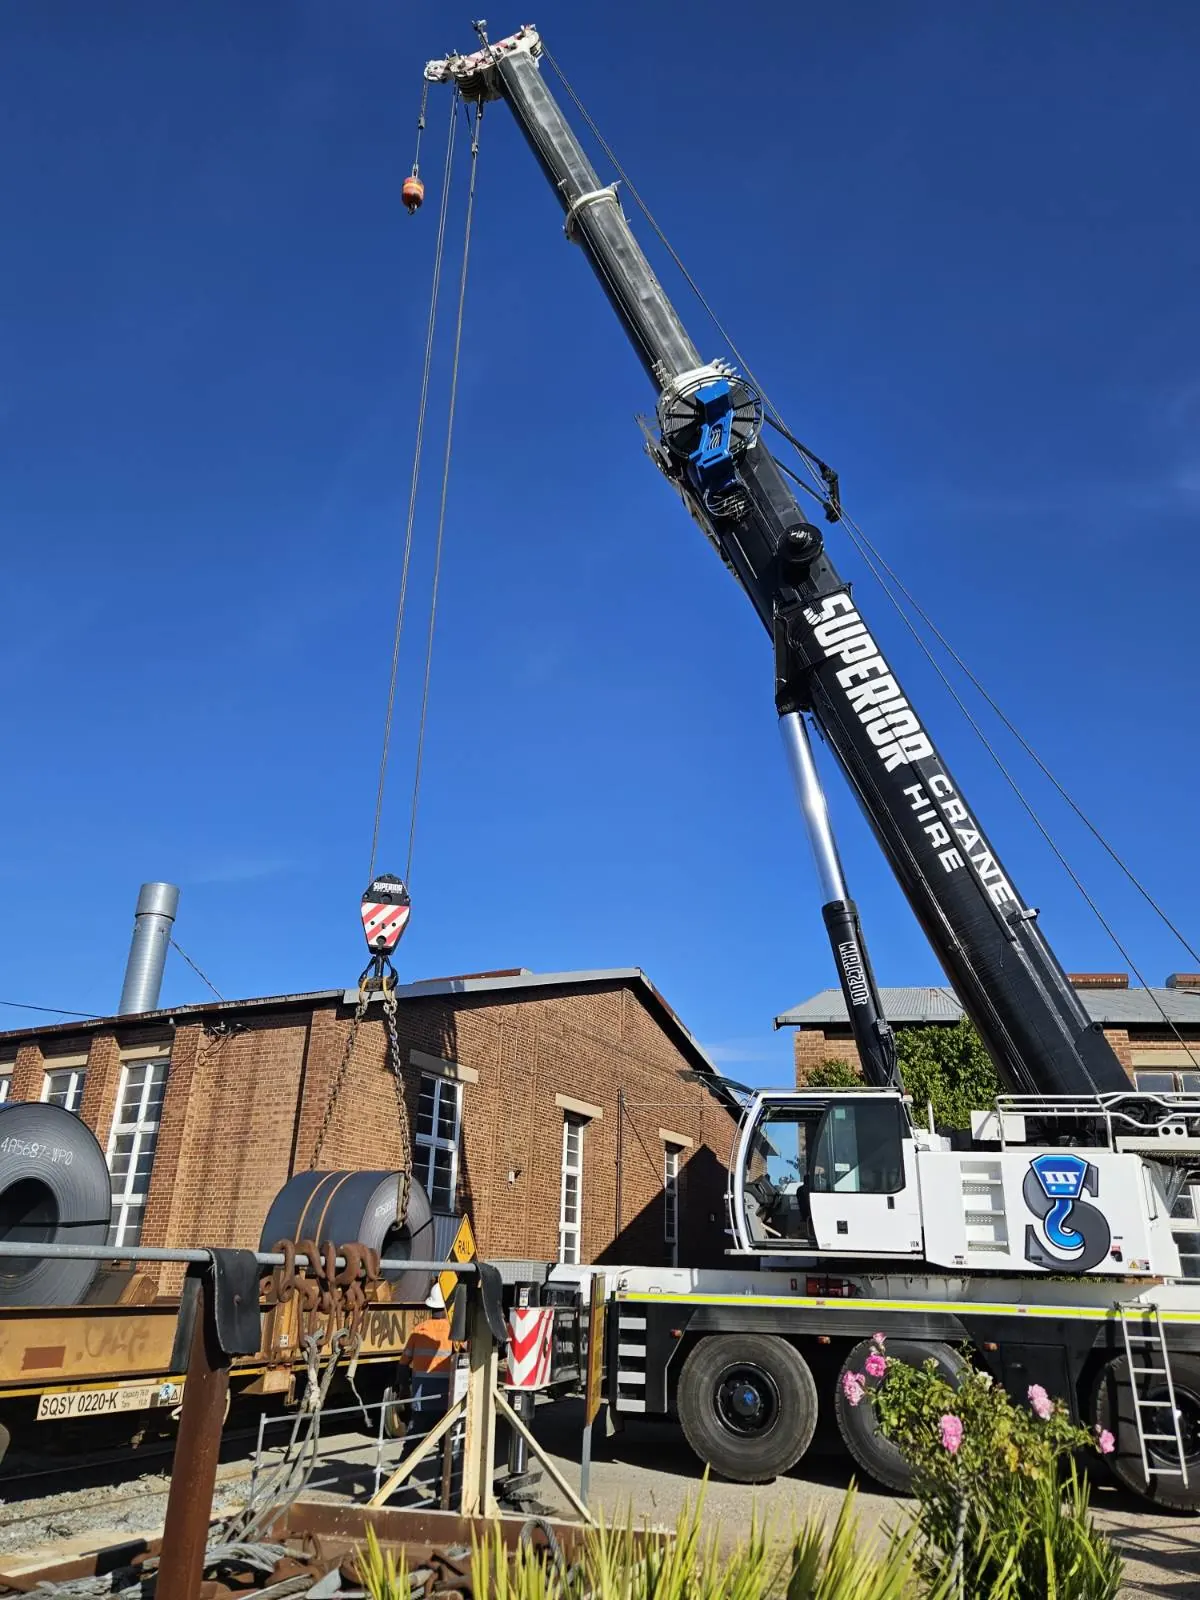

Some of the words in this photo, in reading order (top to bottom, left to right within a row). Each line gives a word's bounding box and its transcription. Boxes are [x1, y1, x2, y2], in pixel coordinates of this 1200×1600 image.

[803, 593, 934, 773] SUPERIOR
[904, 783, 966, 873] HIRE
[928, 774, 1015, 906] CRANE
[457, 1240, 471, 1255] RAIL
[41, 1396, 76, 1416] SQSY
[78, 1391, 118, 1413] 0220-K
